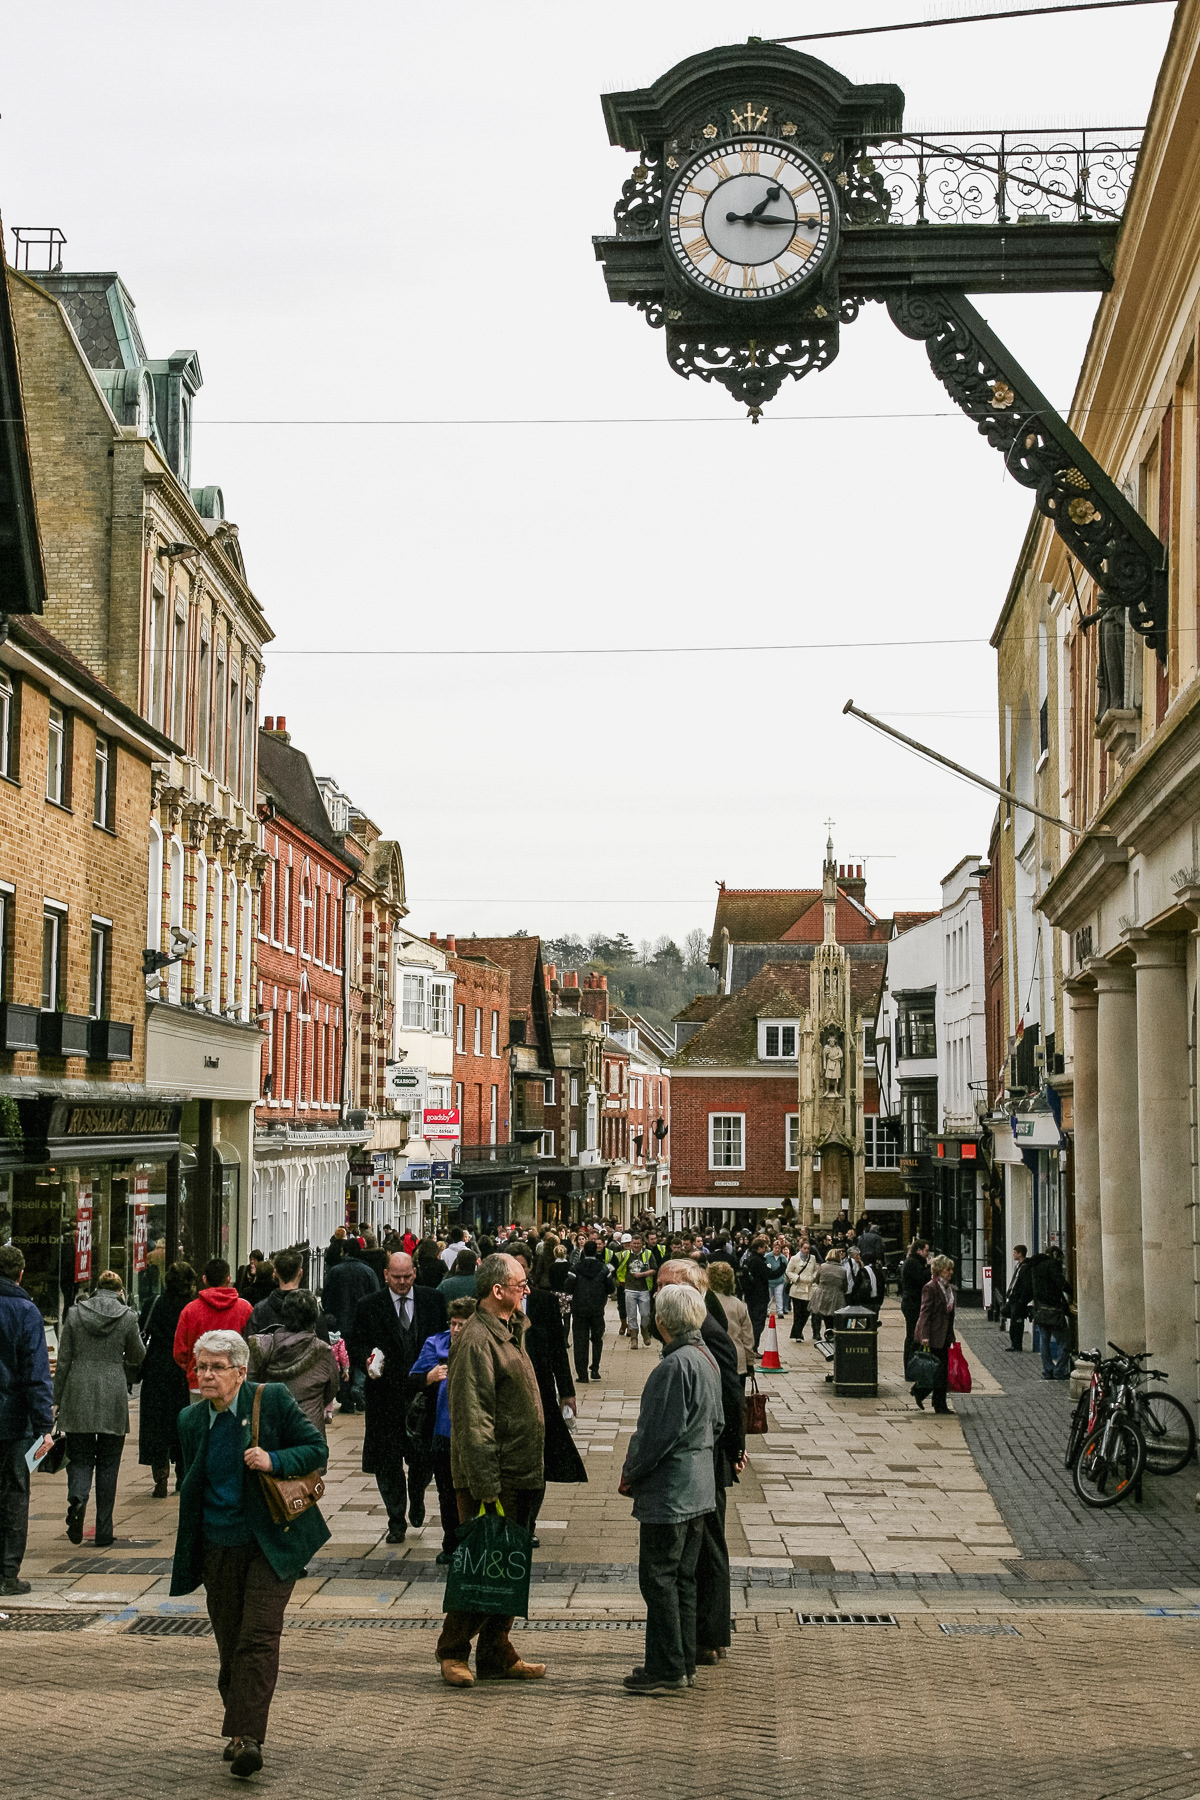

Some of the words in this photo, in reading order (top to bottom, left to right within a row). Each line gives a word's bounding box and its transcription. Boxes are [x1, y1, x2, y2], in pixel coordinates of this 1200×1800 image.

[739, 151, 760, 175] XII
[67, 1108, 118, 1134] RUSSELL
[117, 1108, 129, 1133] &
[426, 1113, 450, 1123] goadsby
[463, 1546, 527, 1580] M&S
